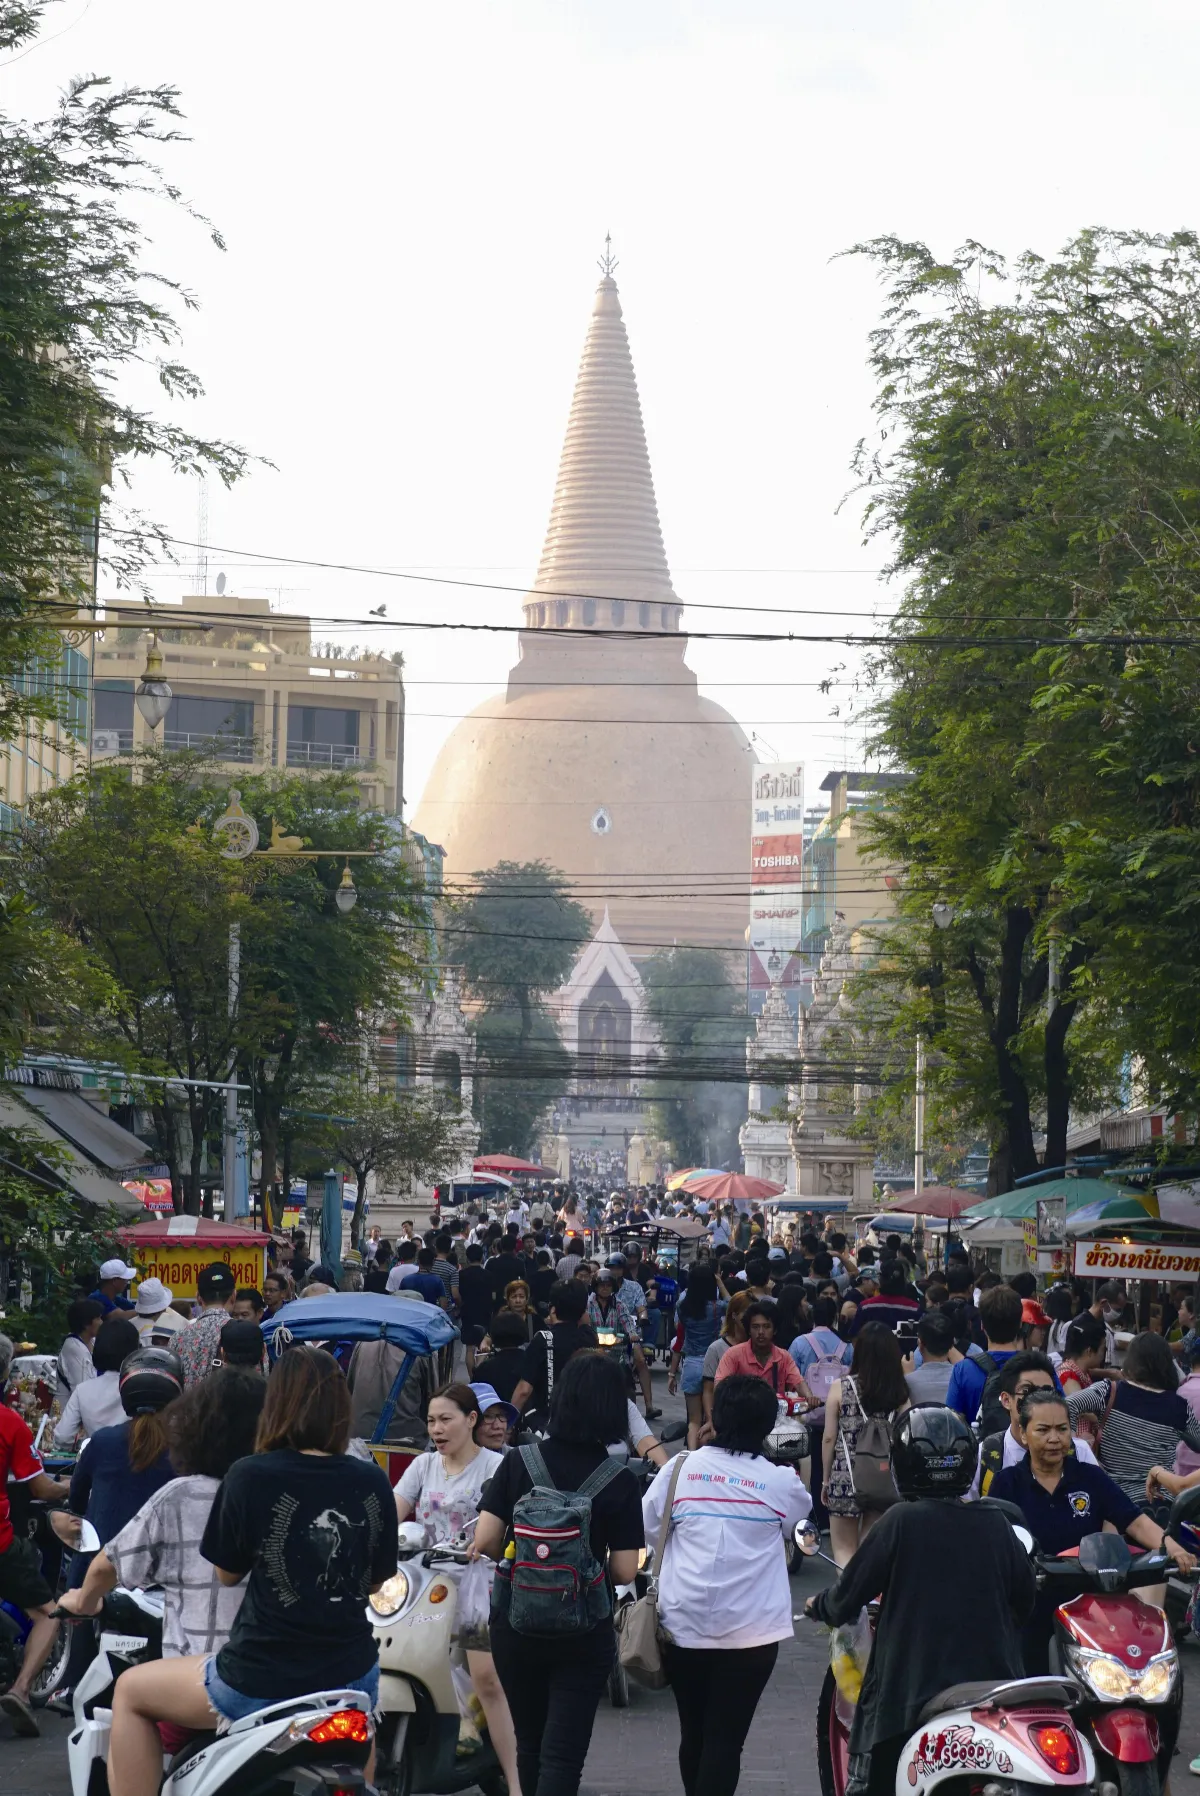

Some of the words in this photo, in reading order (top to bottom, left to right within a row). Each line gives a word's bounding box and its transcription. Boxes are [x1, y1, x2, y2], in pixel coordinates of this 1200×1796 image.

[753, 855, 799, 867] TOSHIBA
[753, 908, 799, 919] SHARP
[687, 1473, 726, 1484] SUANKULARB
[932, 1472, 953, 1480] INDEX
[943, 1742, 993, 1766] SCOOPY
[172, 1751, 207, 1782] CLICK
